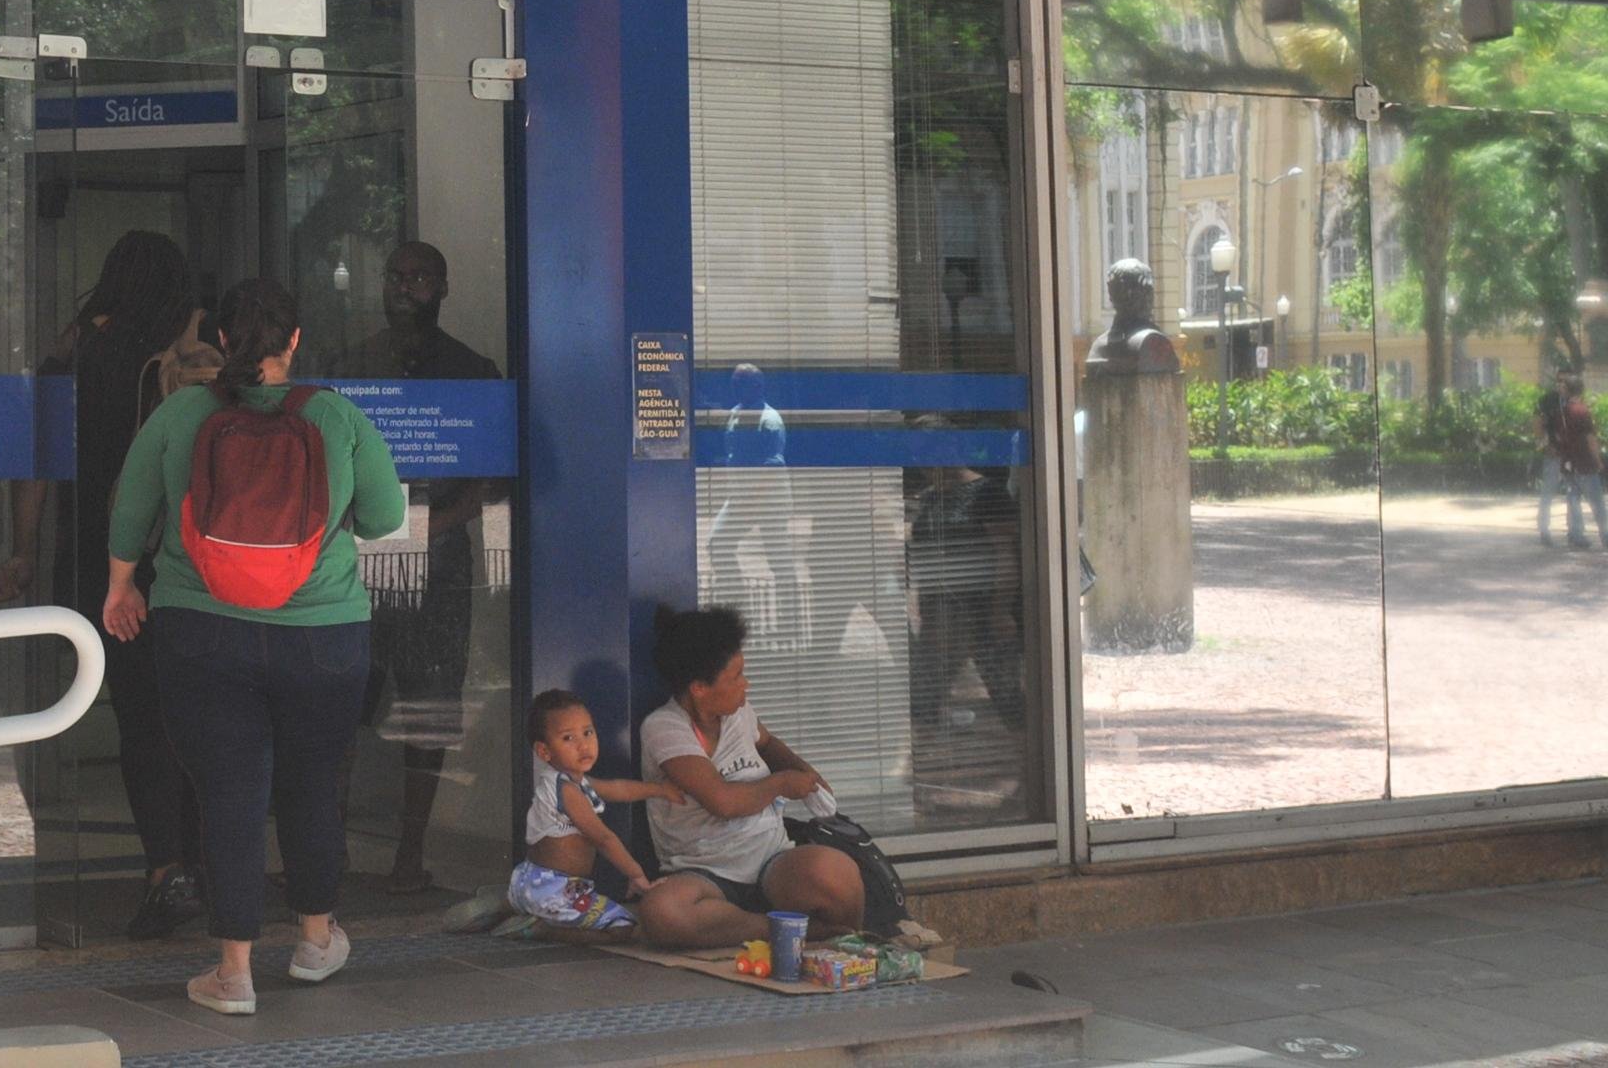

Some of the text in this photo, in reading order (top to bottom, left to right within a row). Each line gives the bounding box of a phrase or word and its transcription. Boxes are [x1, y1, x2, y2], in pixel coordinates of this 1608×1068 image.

[105, 97, 165, 123] Saída
[638, 341, 661, 350] CAIXA
[638, 350, 684, 361] ECONÔMICA
[638, 363, 670, 372] FEDERAL
[341, 385, 380, 397] equipada
[382, 387, 403, 395] com:
[638, 389, 662, 397] NESTA
[638, 398, 673, 408] AGÊNCIA
[375, 407, 406, 415] detector
[407, 407, 418, 415] de
[638, 409, 678, 418] PERMITIDA
[377, 419, 387, 427] TV
[389, 418, 432, 427] monitorado
[638, 419, 685, 428] ENTRADA DE
[403, 430, 412, 439] 24
[395, 443, 422, 451] retardo
[423, 443, 433, 451] de
